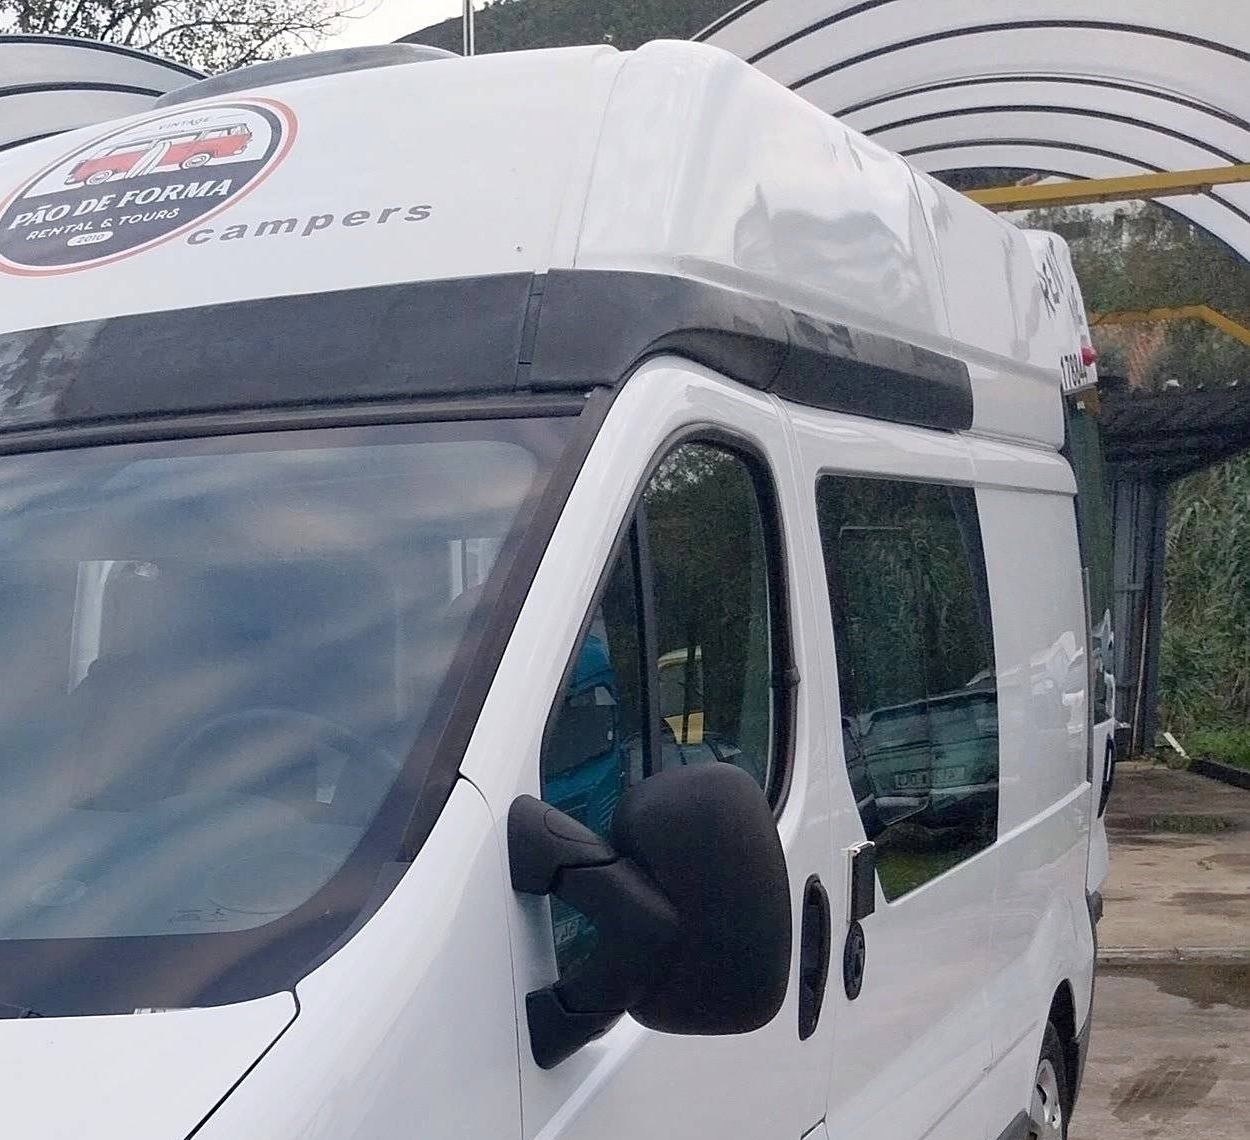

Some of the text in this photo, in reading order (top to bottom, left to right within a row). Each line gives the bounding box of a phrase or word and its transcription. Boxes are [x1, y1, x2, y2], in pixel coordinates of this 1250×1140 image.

[8, 179, 233, 230] PÃO DE FORMA
[26, 208, 180, 241] RENTAL & TOURS
[186, 204, 432, 245] campers
